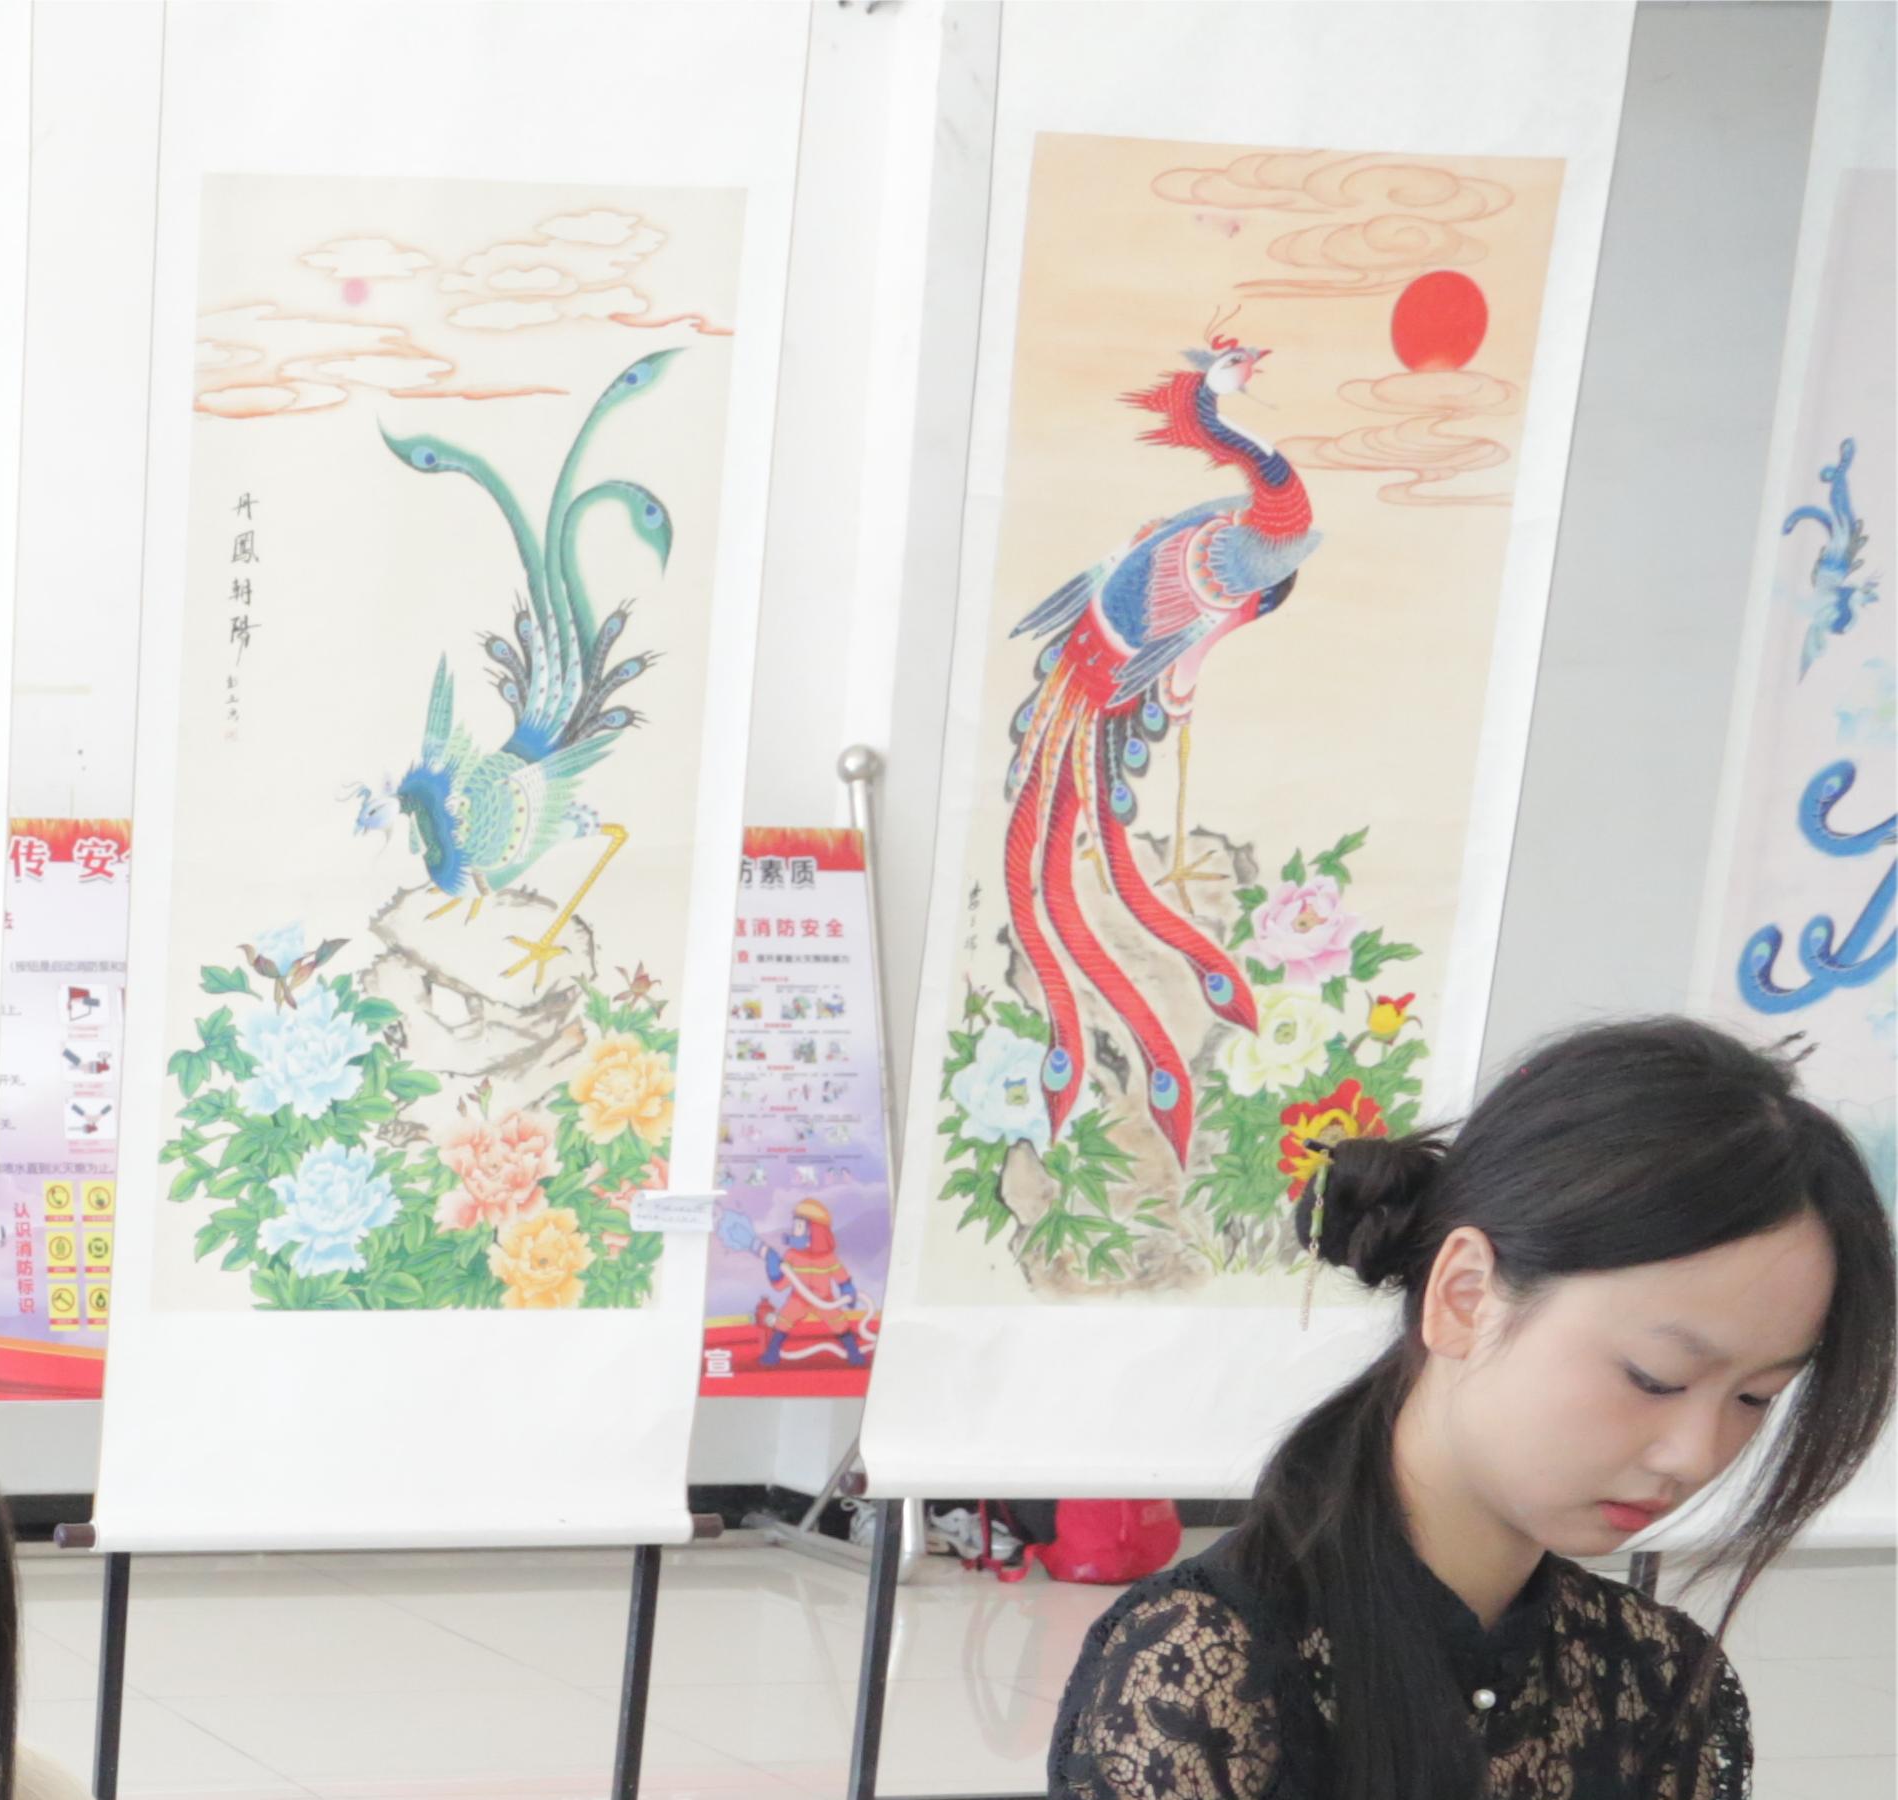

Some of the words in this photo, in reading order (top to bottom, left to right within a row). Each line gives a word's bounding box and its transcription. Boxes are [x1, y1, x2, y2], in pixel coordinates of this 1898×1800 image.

[13, 1201, 35, 1315] 认识消防标识
